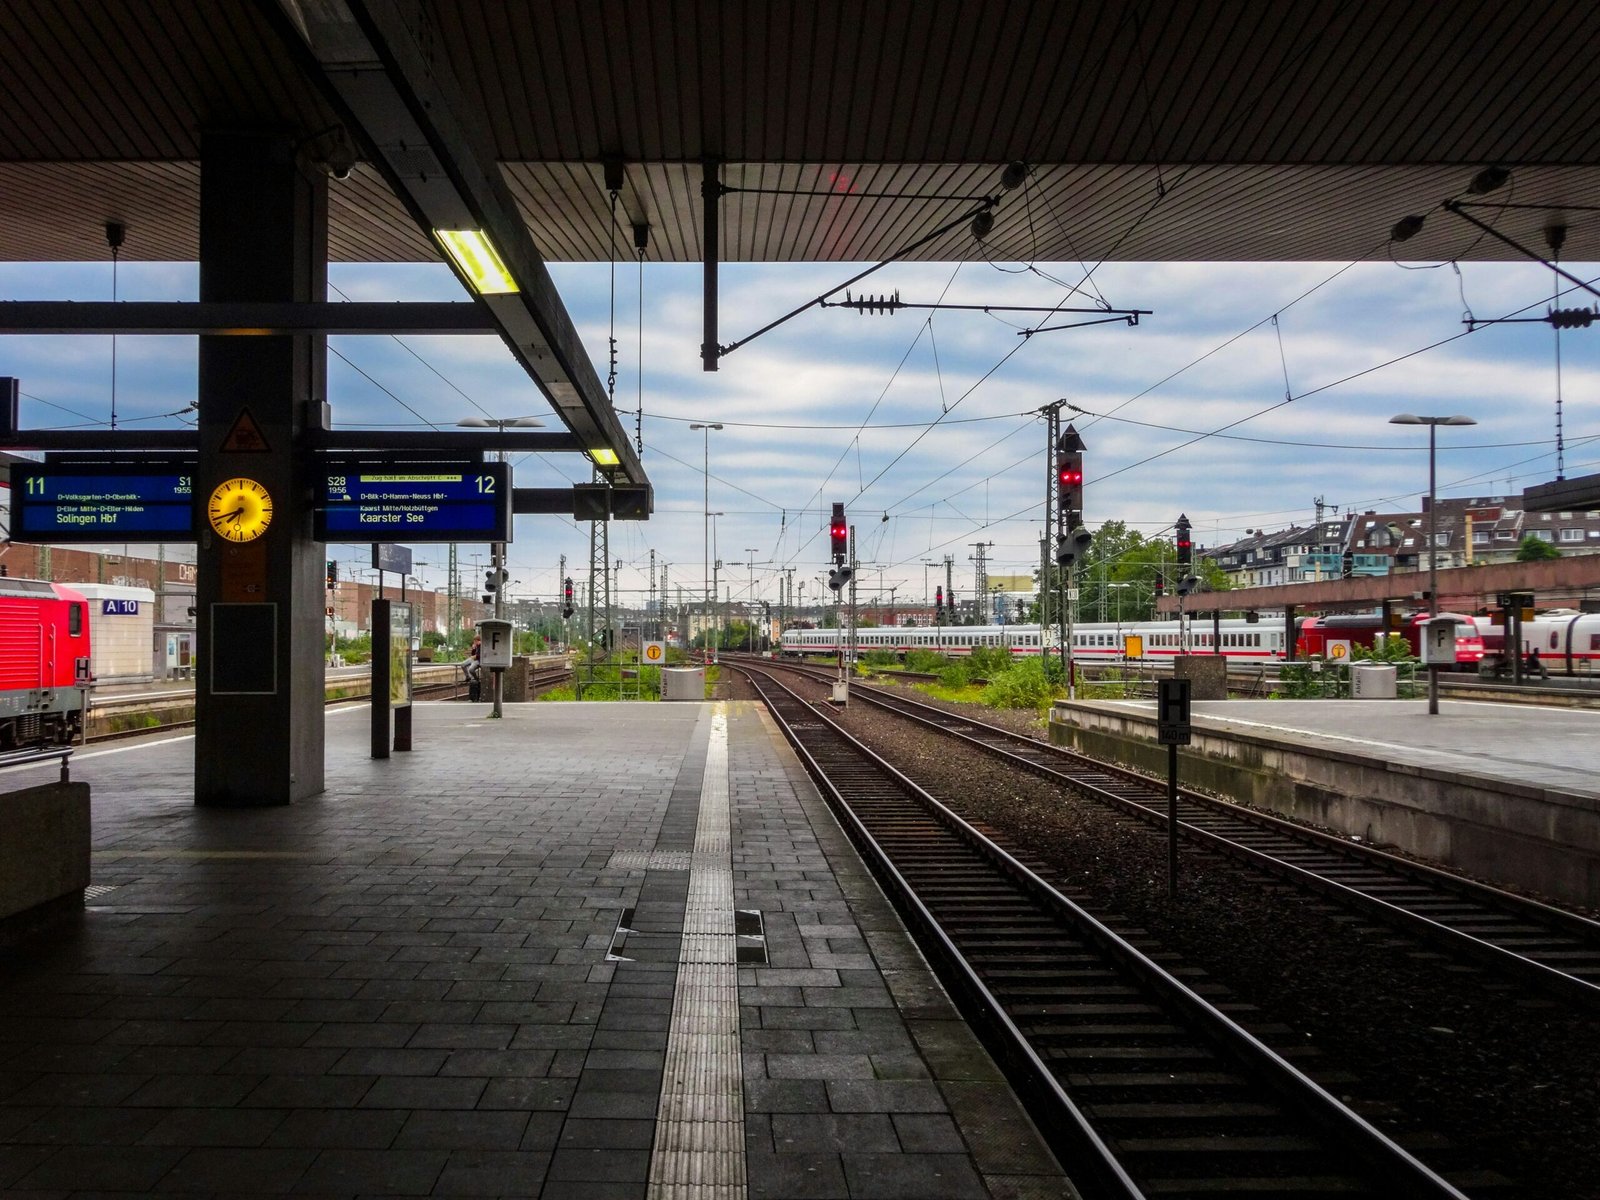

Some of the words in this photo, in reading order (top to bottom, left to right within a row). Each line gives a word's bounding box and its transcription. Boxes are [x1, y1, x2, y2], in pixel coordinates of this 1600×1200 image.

[26, 477, 45, 495] 11
[179, 476, 191, 486] S1
[328, 476, 346, 486] S28
[475, 476, 495, 493] 12
[57, 513, 97, 525] Solingen
[100, 513, 117, 523] Hbf
[360, 513, 402, 523] Kaarster
[406, 513, 424, 523] See
[107, 601, 116, 612] A
[122, 601, 136, 612] 10
[492, 632, 501, 650] F
[1437, 629, 1446, 647] F
[77, 659, 89, 678] H
[1162, 684, 1187, 721] H
